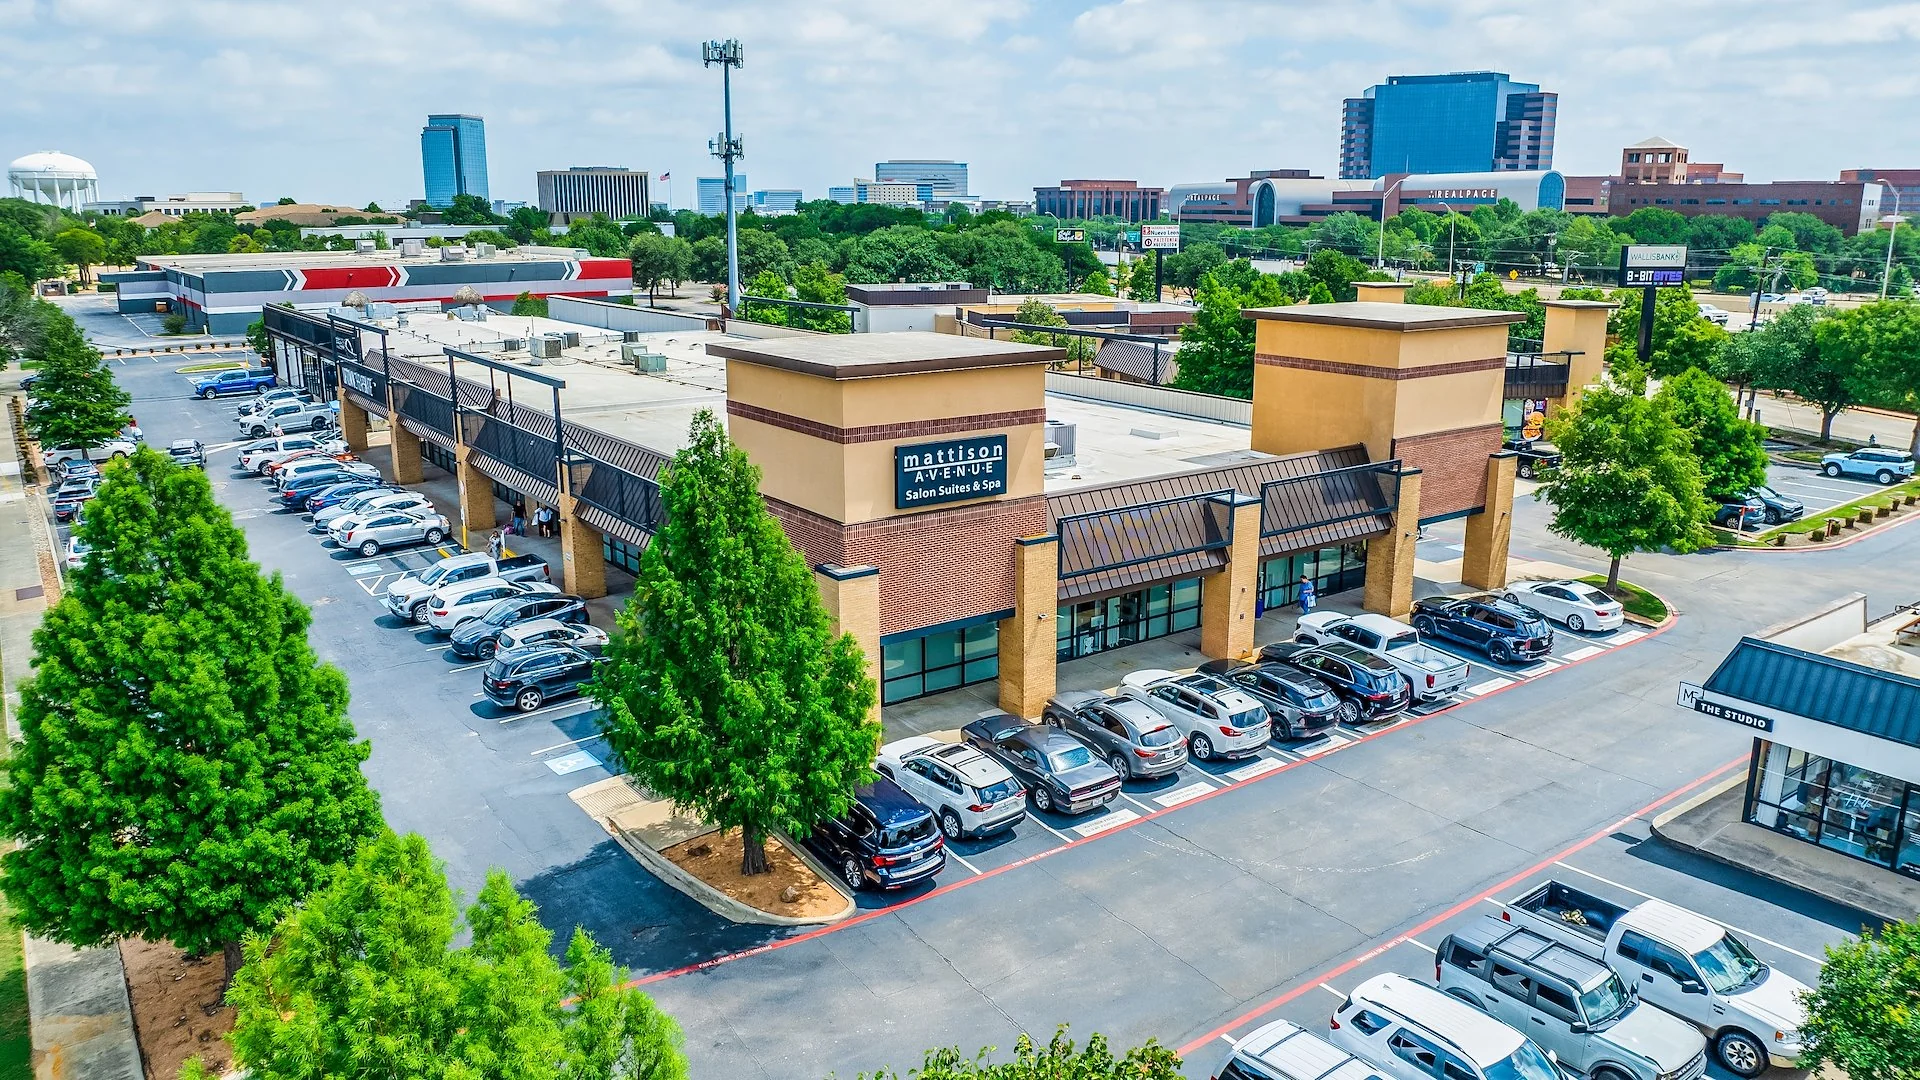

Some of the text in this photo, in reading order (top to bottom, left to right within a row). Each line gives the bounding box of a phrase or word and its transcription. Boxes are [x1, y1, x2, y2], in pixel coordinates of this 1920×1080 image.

[1437, 190, 1495, 198] REALPAGE
[1631, 252, 1675, 261] WALLISBANK
[904, 444, 1002, 468] mattison
[905, 479, 1001, 501] Salon Suites & Spa
[1700, 703, 1766, 728] THE STUDIO
[698, 961, 714, 969] FIRE
[713, 956, 731, 964] LANE
[745, 944, 773, 956] PARKING
